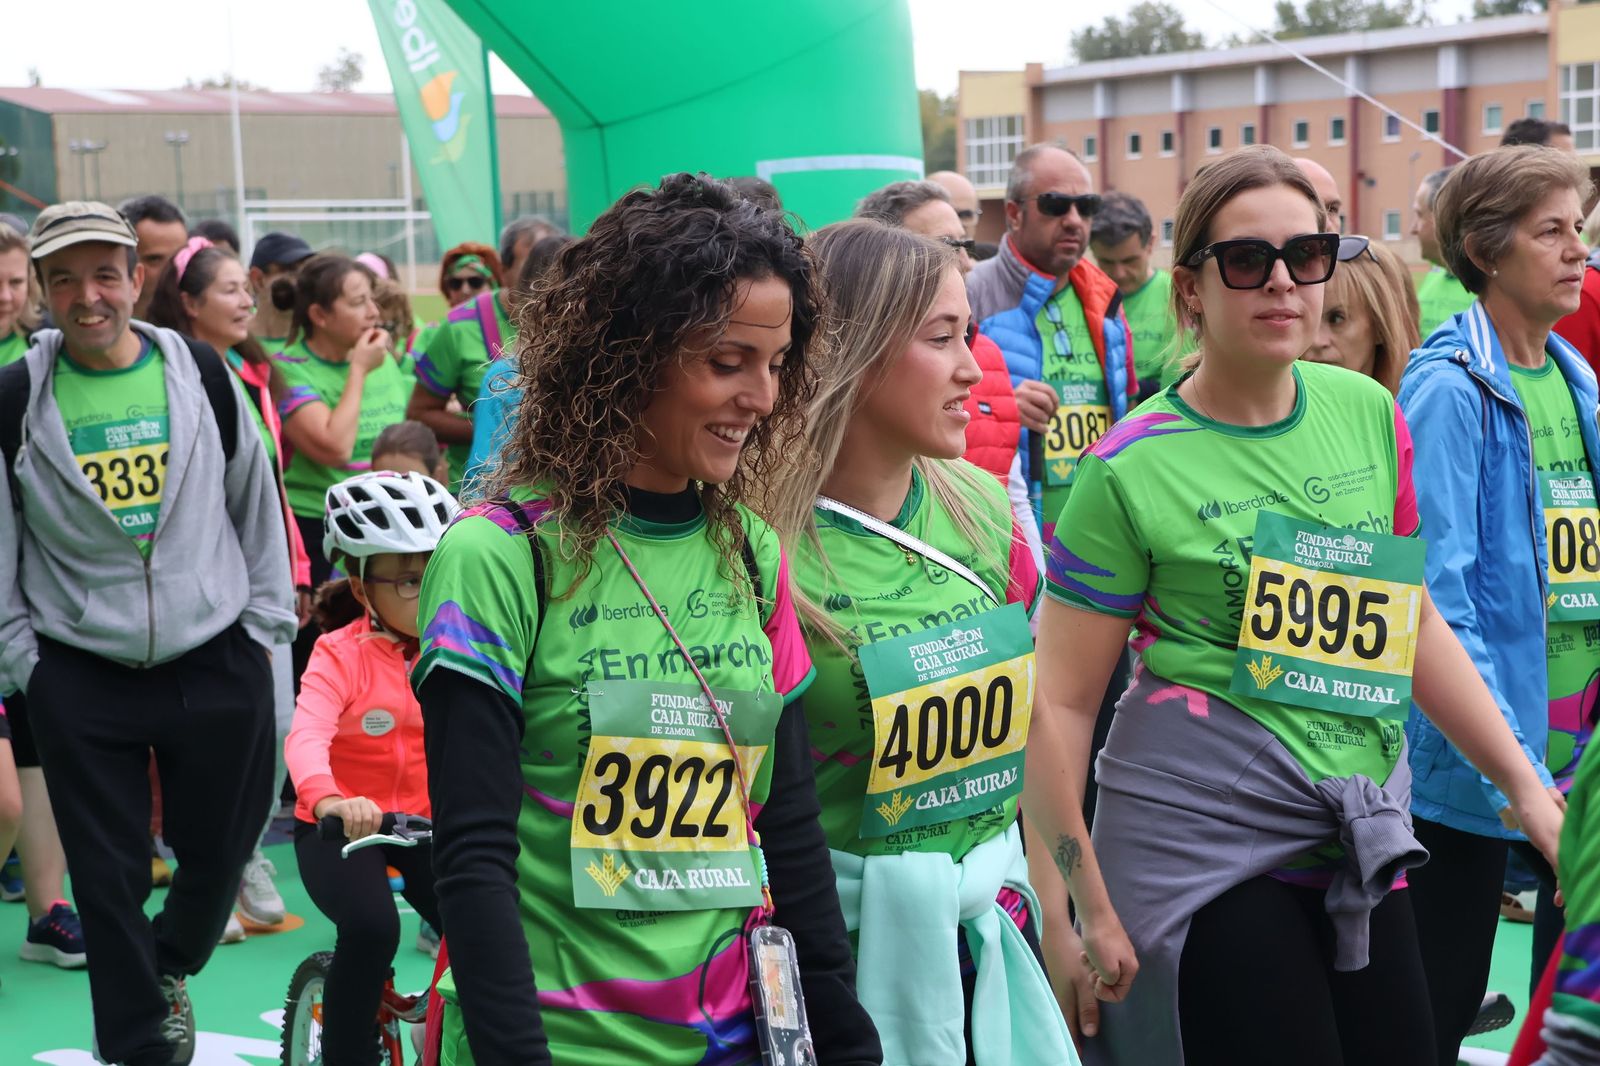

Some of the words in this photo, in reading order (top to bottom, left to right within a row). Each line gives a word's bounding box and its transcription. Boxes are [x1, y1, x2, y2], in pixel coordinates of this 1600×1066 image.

[1223, 490, 1290, 516] Iberdrola
[122, 512, 154, 527] CAJA
[1295, 542, 1321, 560] CAJA
[1326, 549, 1372, 566] RURAL
[1545, 516, 1600, 574] 08
[1304, 557, 1334, 569] ZAMORA
[601, 602, 669, 621] Iberdrola
[1560, 592, 1599, 608] CAJA
[1251, 570, 1389, 660] 5995
[600, 647, 649, 682] En
[913, 653, 943, 673] CAJA
[943, 642, 988, 664] RURAL
[918, 673, 928, 682] DE
[929, 666, 958, 679] ZAMORA
[1284, 671, 1328, 695] CAJA
[1332, 680, 1400, 704] RURAL
[651, 708, 684, 725] CAJA
[878, 675, 1013, 778] 4000
[651, 726, 662, 735] DE
[665, 726, 695, 737] ZAMORA
[1307, 730, 1331, 742] CAJA
[1335, 734, 1367, 748] RURAL
[583, 752, 736, 839] 3922
[915, 785, 961, 810] CAJA
[965, 766, 1018, 799] RURAL
[885, 832, 913, 845] CAJA
[634, 868, 685, 891] CAJA
[687, 868, 750, 889] RURAL
